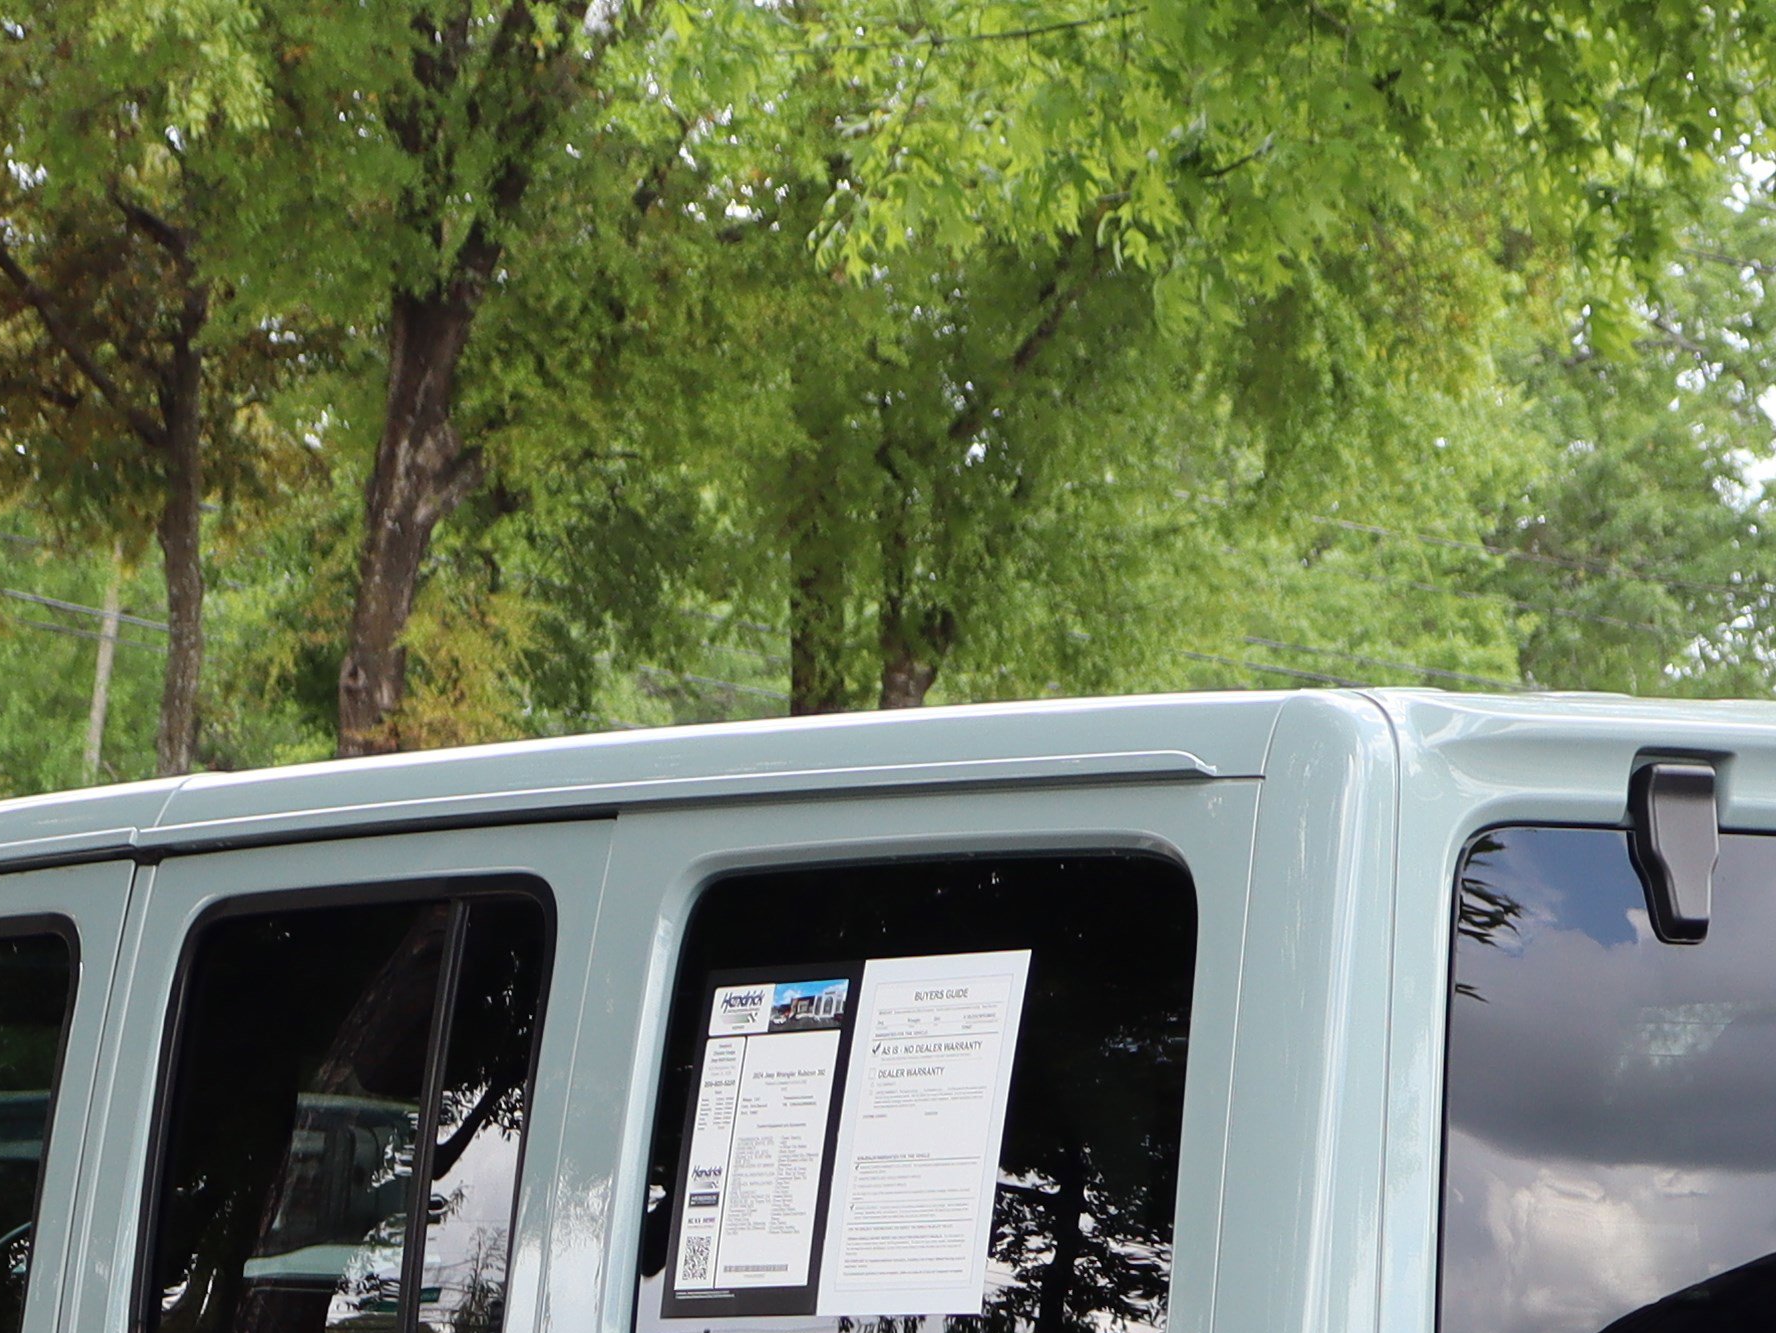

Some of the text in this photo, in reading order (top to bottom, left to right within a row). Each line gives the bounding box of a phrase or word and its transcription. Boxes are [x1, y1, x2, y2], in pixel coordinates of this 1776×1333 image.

[914, 988, 969, 1001] BUYERS GUIDE
[721, 990, 765, 1014] Hendrick
[881, 1046, 891, 1055] AS
[892, 1046, 898, 1054] IS
[904, 1045, 915, 1054] NO
[915, 1043, 943, 1054] DEALER
[944, 1040, 983, 1051] WARRANTY
[877, 1066, 945, 1079] DEALER WARRANTY
